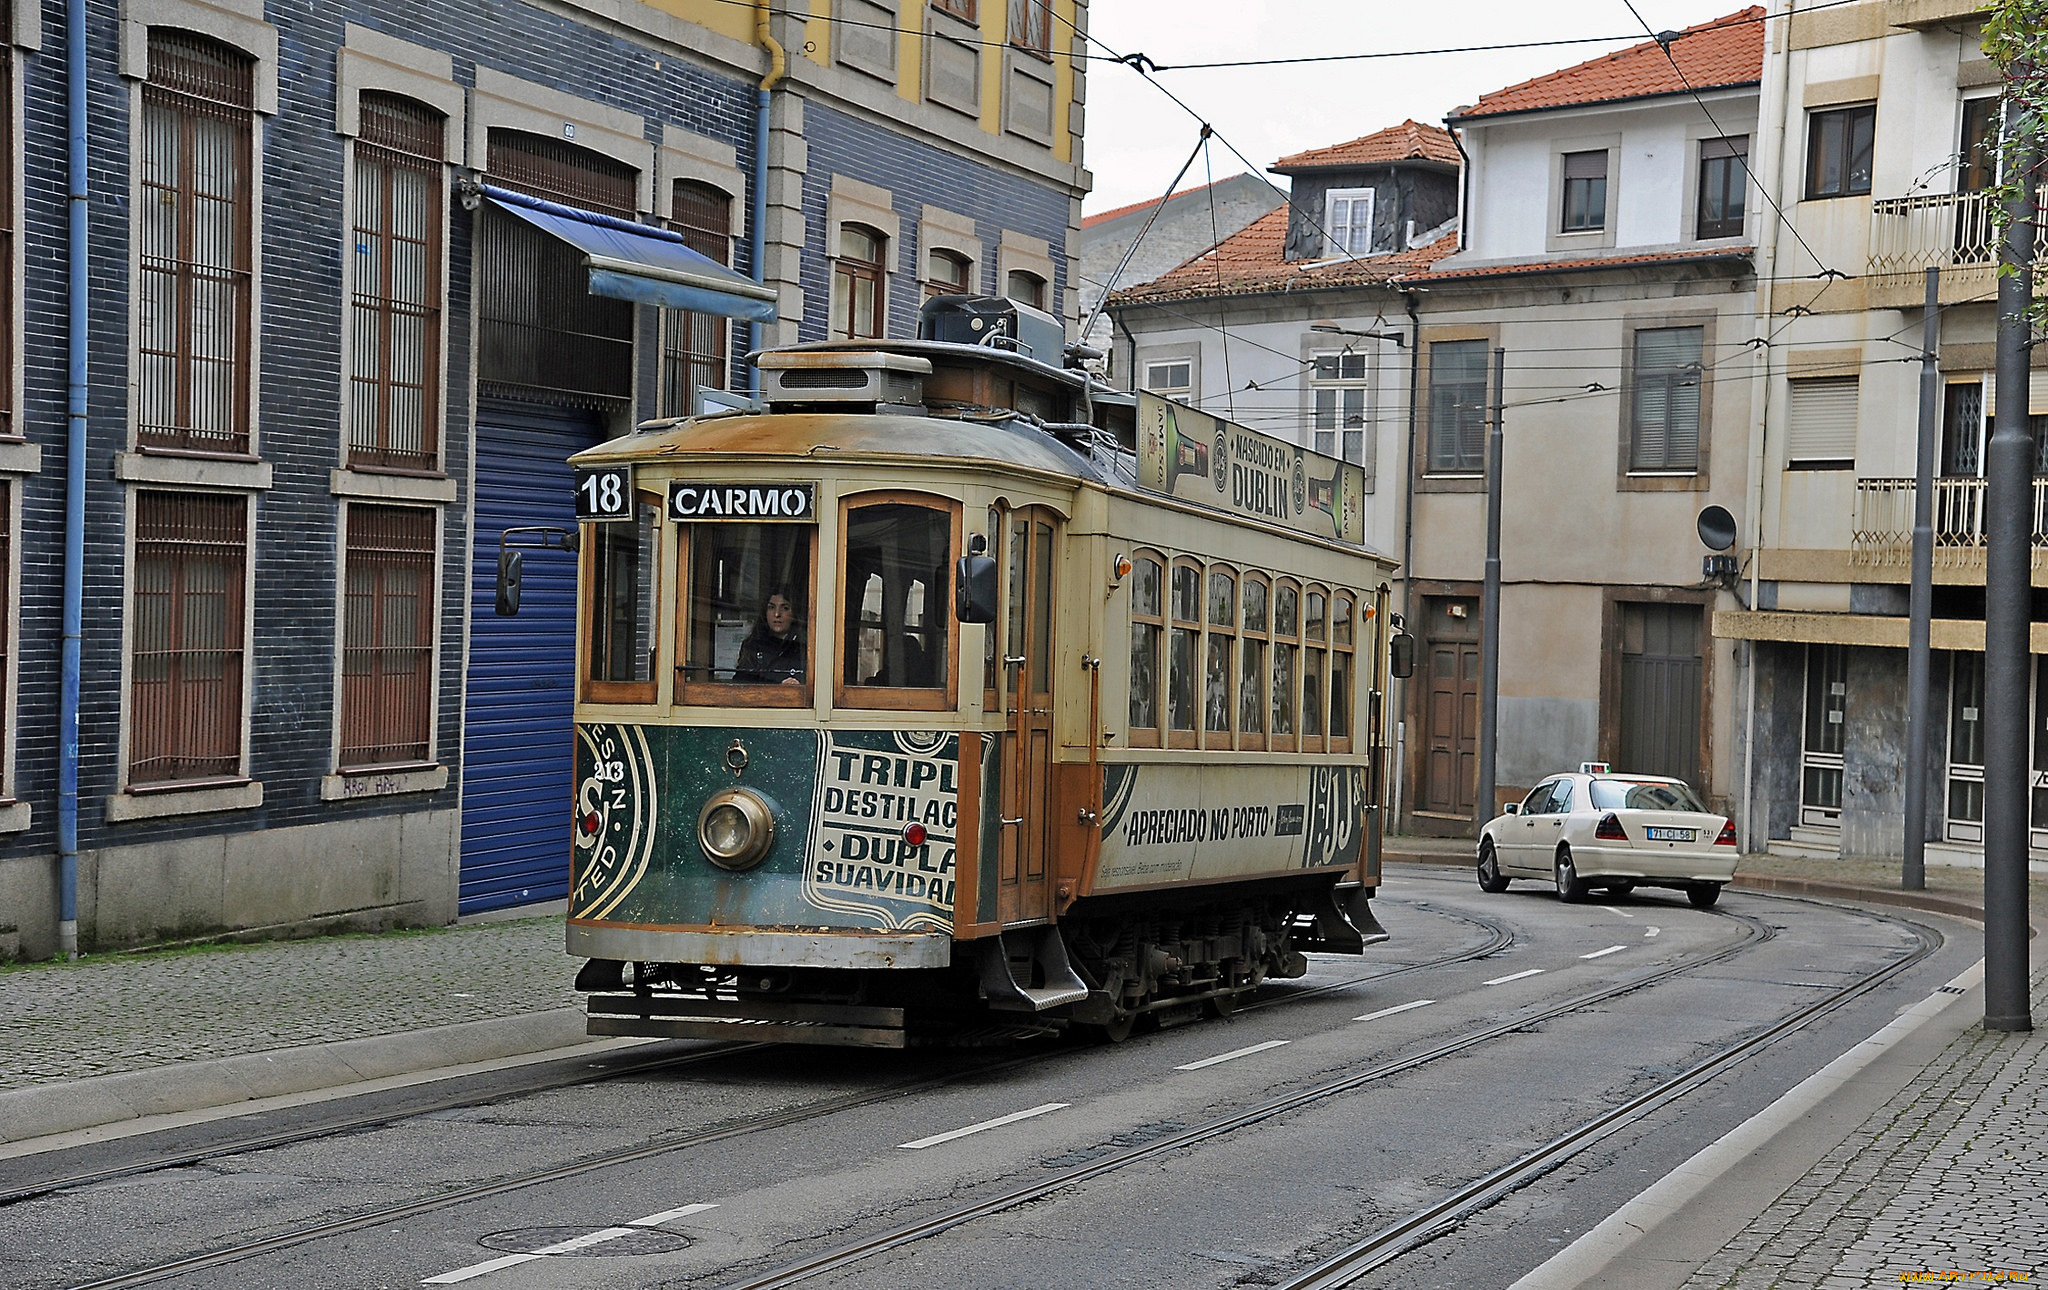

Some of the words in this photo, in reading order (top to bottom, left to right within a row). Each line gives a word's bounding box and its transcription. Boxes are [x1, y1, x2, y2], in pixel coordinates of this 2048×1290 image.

[1235, 434, 1273, 470] NASCIDO
[1274, 447, 1286, 473] EM
[581, 473, 622, 513] 18
[675, 487, 806, 516] CARMO
[1232, 462, 1288, 520] DUBLIN
[594, 761, 624, 780] 213
[830, 750, 957, 793] TRIPL
[1127, 809, 1207, 846] APRECIADO
[1209, 807, 1229, 841] NO
[1231, 806, 1269, 838] PORTO
